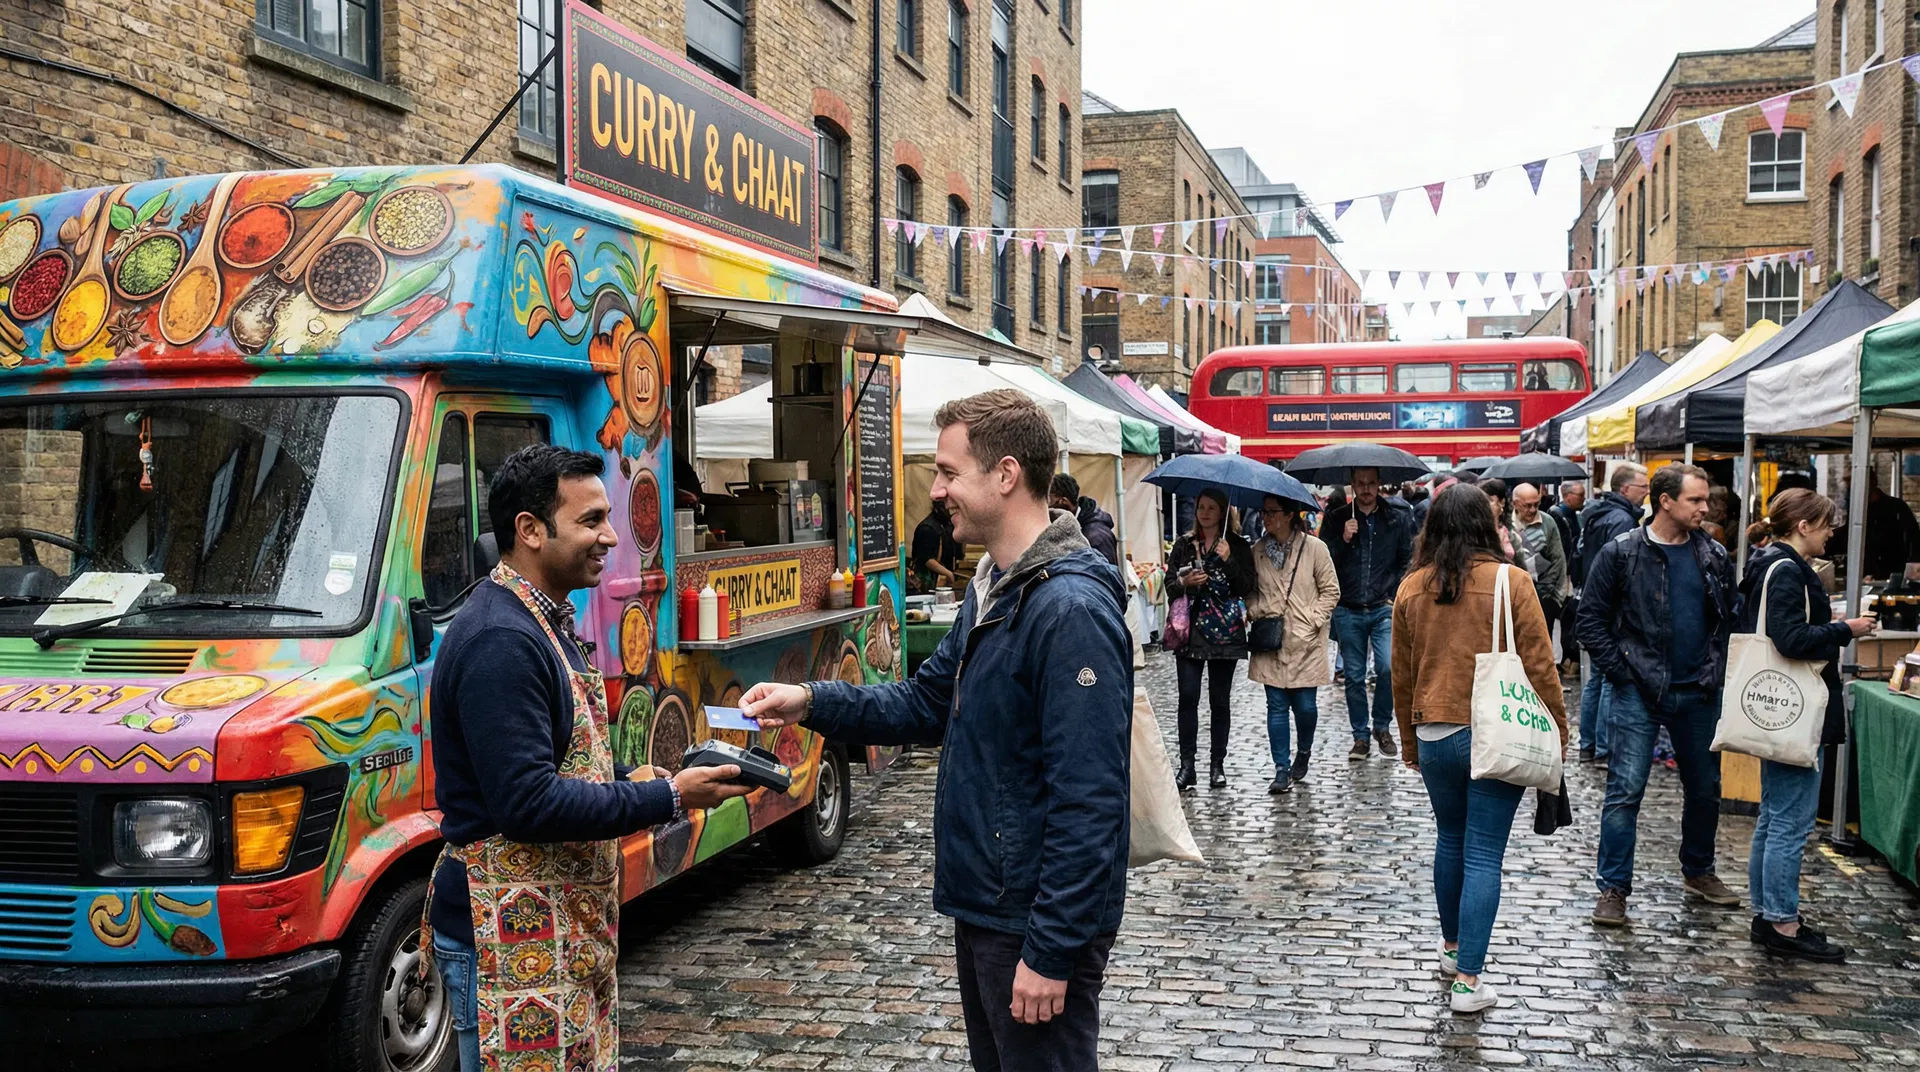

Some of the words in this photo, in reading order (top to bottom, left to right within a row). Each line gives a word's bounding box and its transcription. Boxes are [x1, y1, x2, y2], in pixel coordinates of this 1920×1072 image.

[591, 62, 696, 183] CURRY
[704, 123, 724, 197] &
[732, 131, 805, 226] CHAAT
[755, 571, 763, 607] &
[764, 567, 797, 604] CHAAT
[1501, 704, 1512, 723] &
